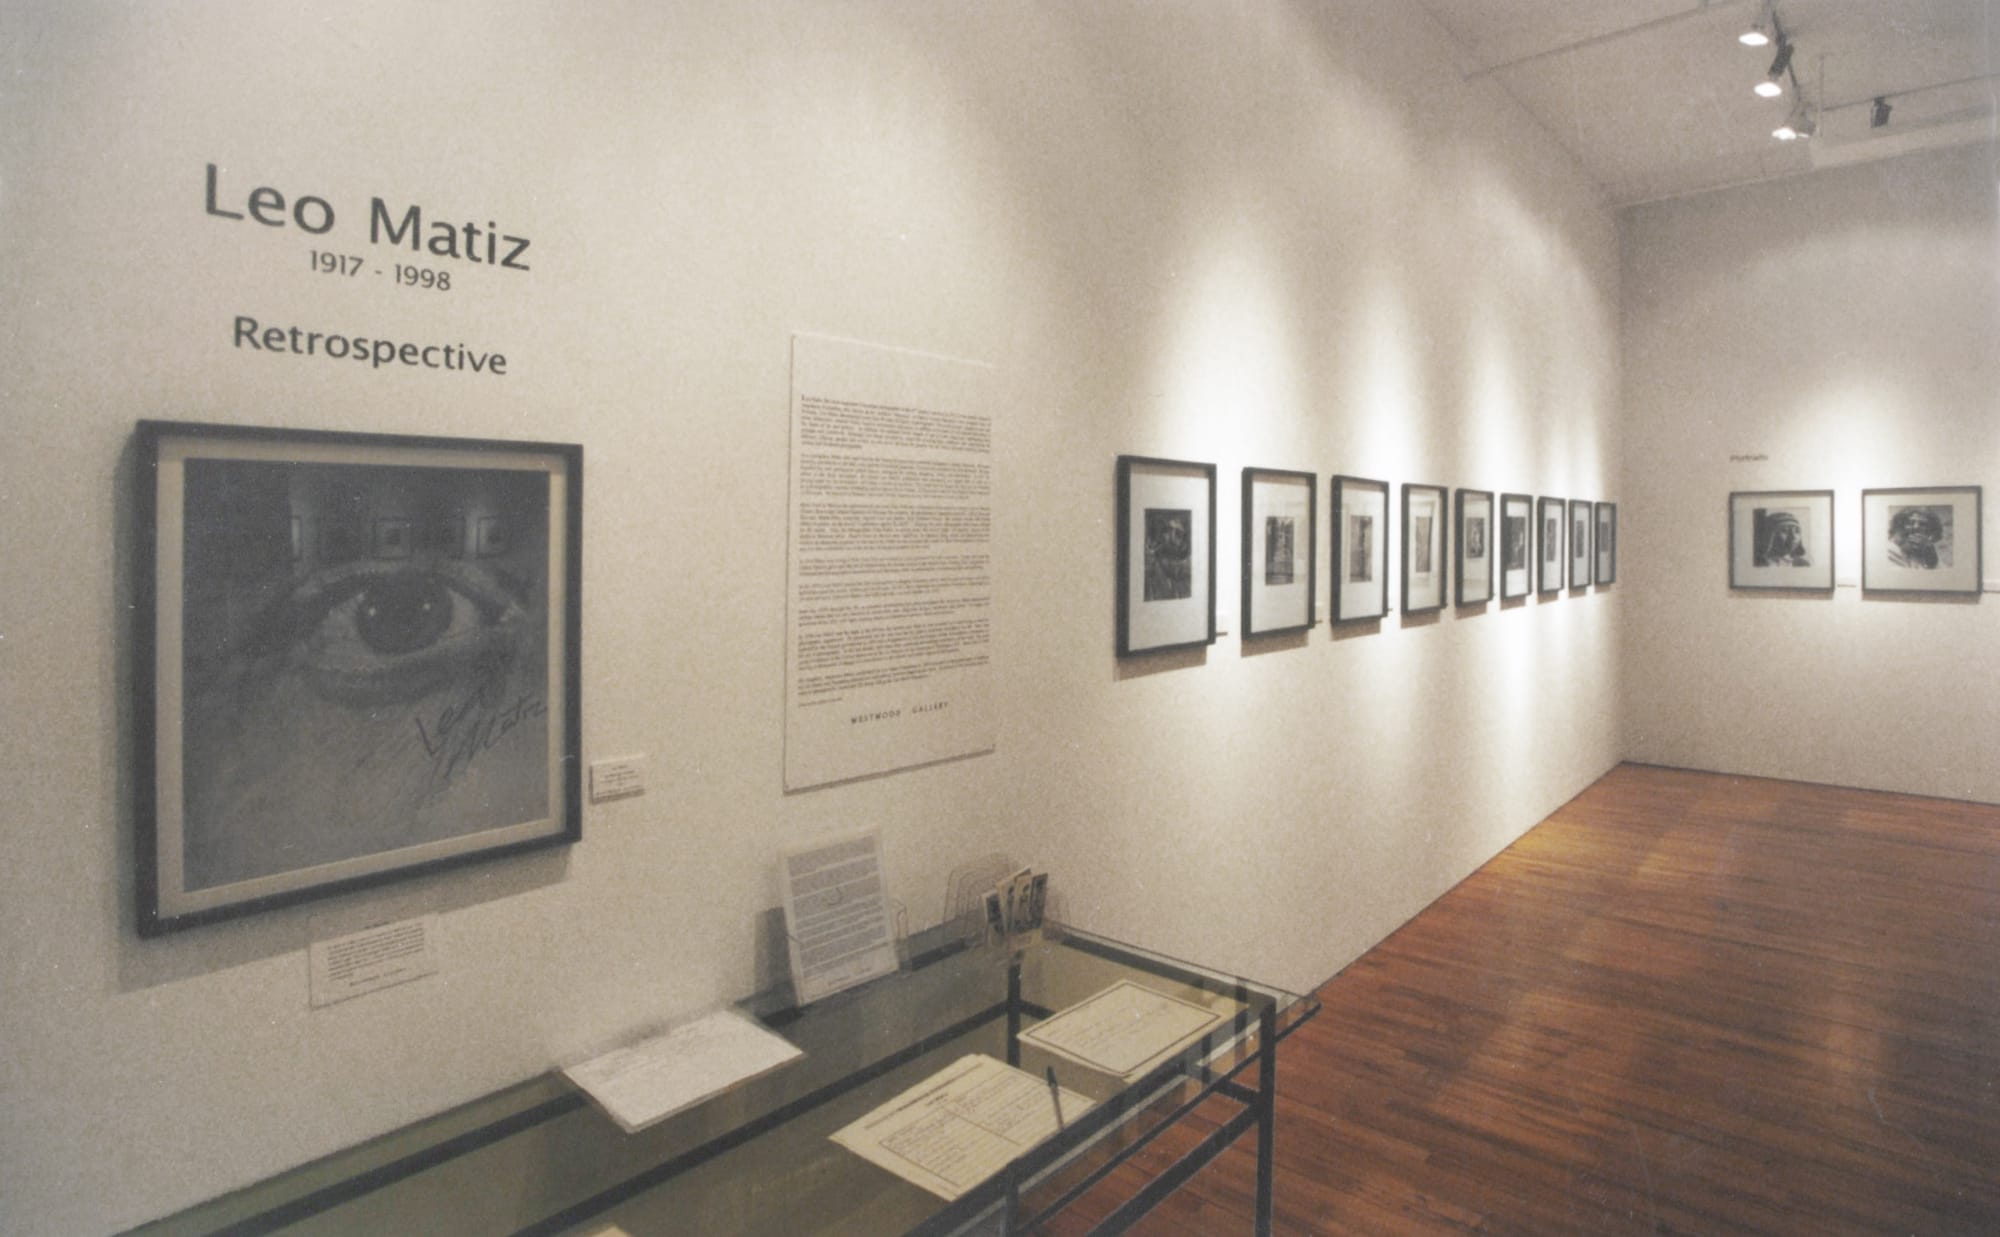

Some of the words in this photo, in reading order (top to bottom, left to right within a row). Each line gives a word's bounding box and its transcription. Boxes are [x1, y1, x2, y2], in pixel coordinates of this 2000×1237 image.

[206, 163, 335, 234] Leo
[370, 196, 531, 271] Matiz
[310, 250, 364, 277] 1917
[395, 264, 451, 291] 1998
[233, 315, 507, 374] Retrospective
[851, 709, 902, 724] WESTWOOD
[911, 701, 949, 715] GALLERY
